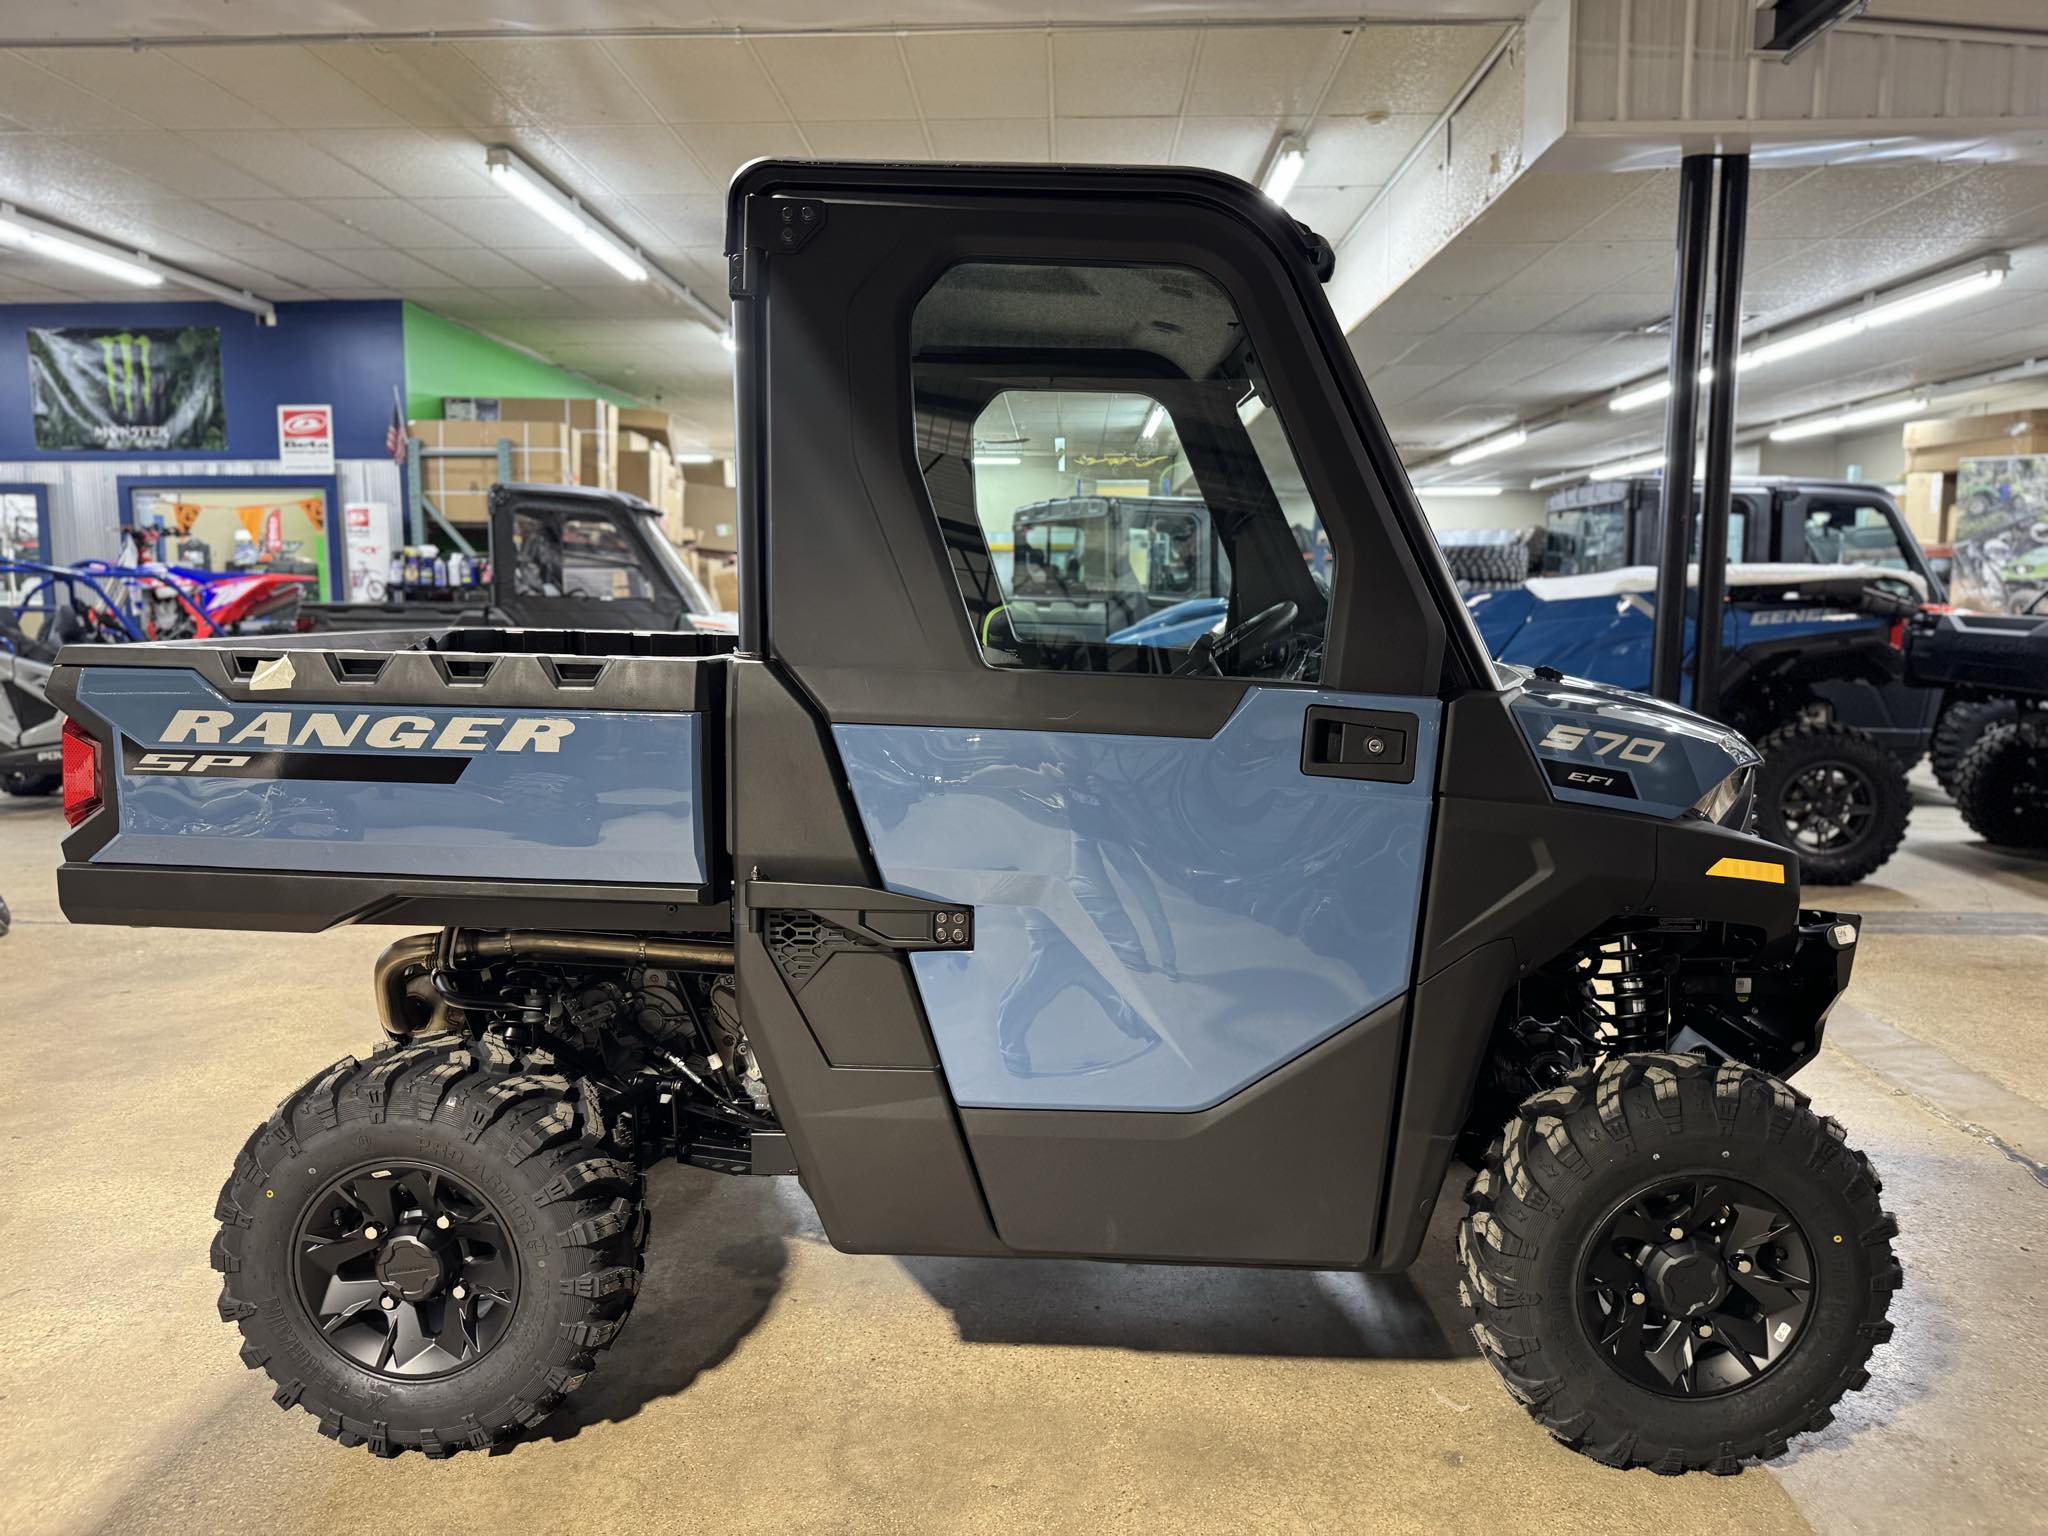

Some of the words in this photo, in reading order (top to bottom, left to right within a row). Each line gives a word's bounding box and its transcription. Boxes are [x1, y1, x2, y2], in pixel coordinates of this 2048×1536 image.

[93, 425, 170, 440] MONSTER
[1749, 607, 1855, 626] GENE
[158, 709, 576, 753] RANGER
[1539, 724, 1666, 763] 570
[133, 754, 252, 772] SP
[1567, 771, 1615, 787] EFI
